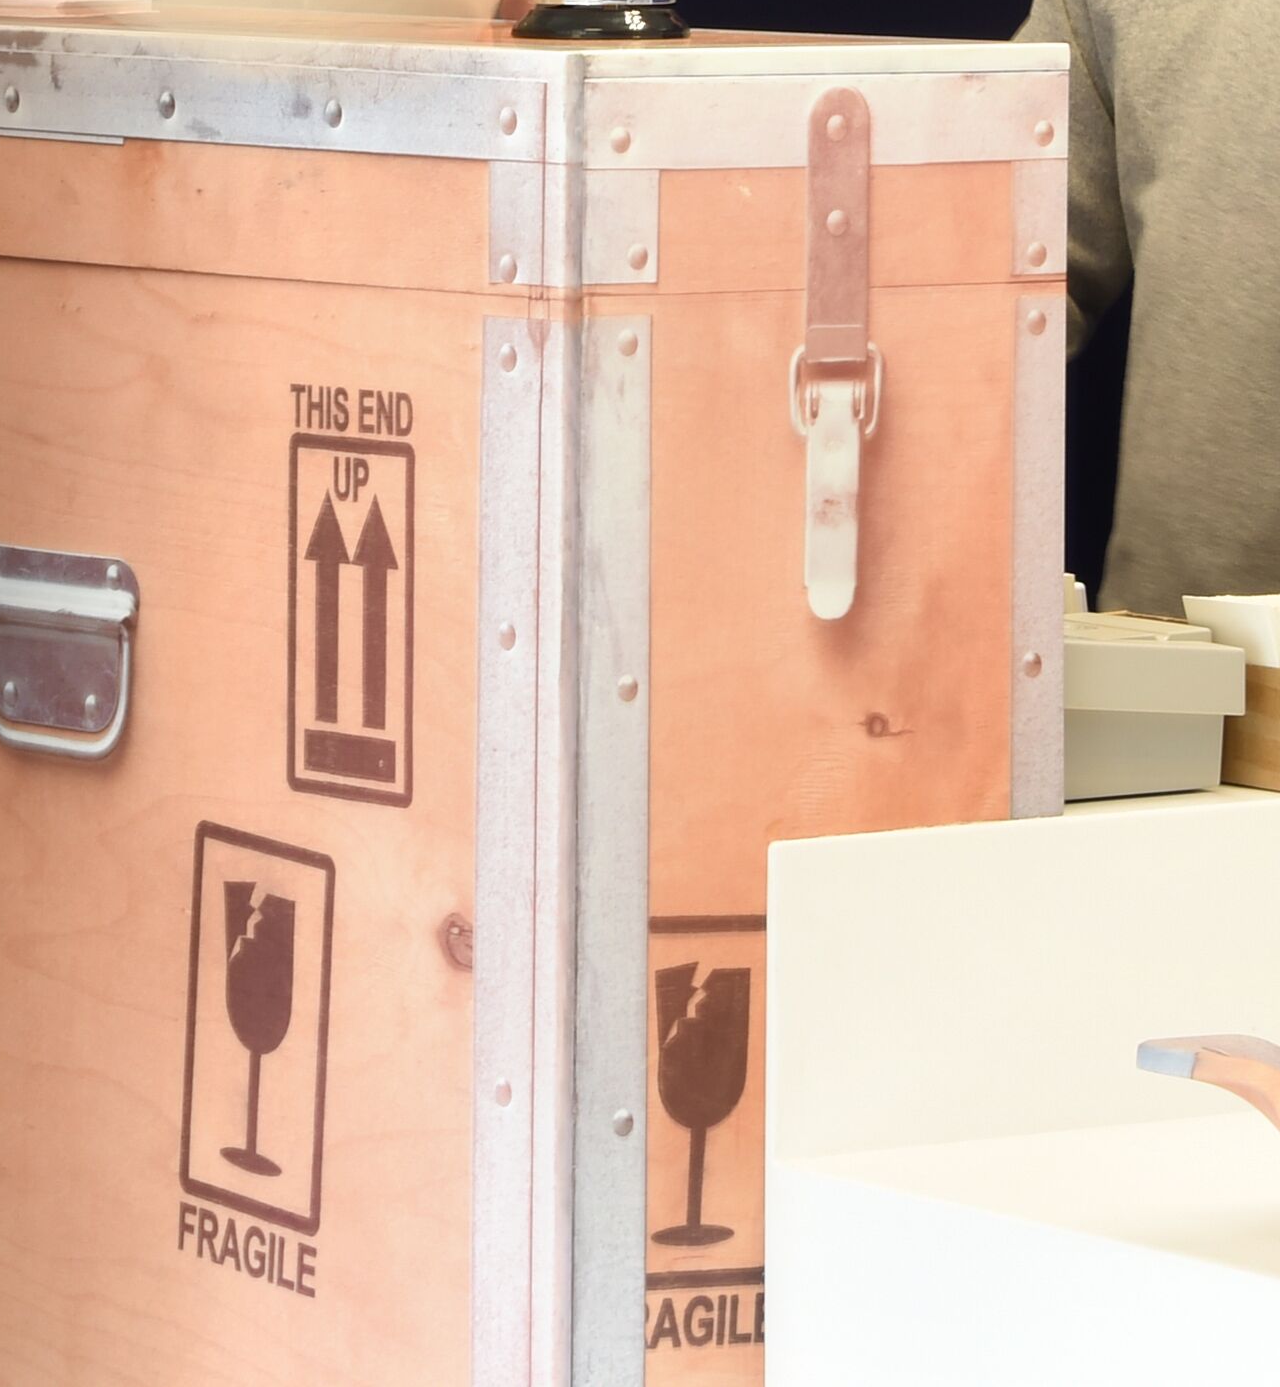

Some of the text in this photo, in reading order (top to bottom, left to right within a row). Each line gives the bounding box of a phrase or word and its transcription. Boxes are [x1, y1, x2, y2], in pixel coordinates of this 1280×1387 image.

[290, 384, 413, 436] THIS END
[333, 456, 369, 503] UP
[177, 1201, 317, 1298] FRAGILE
